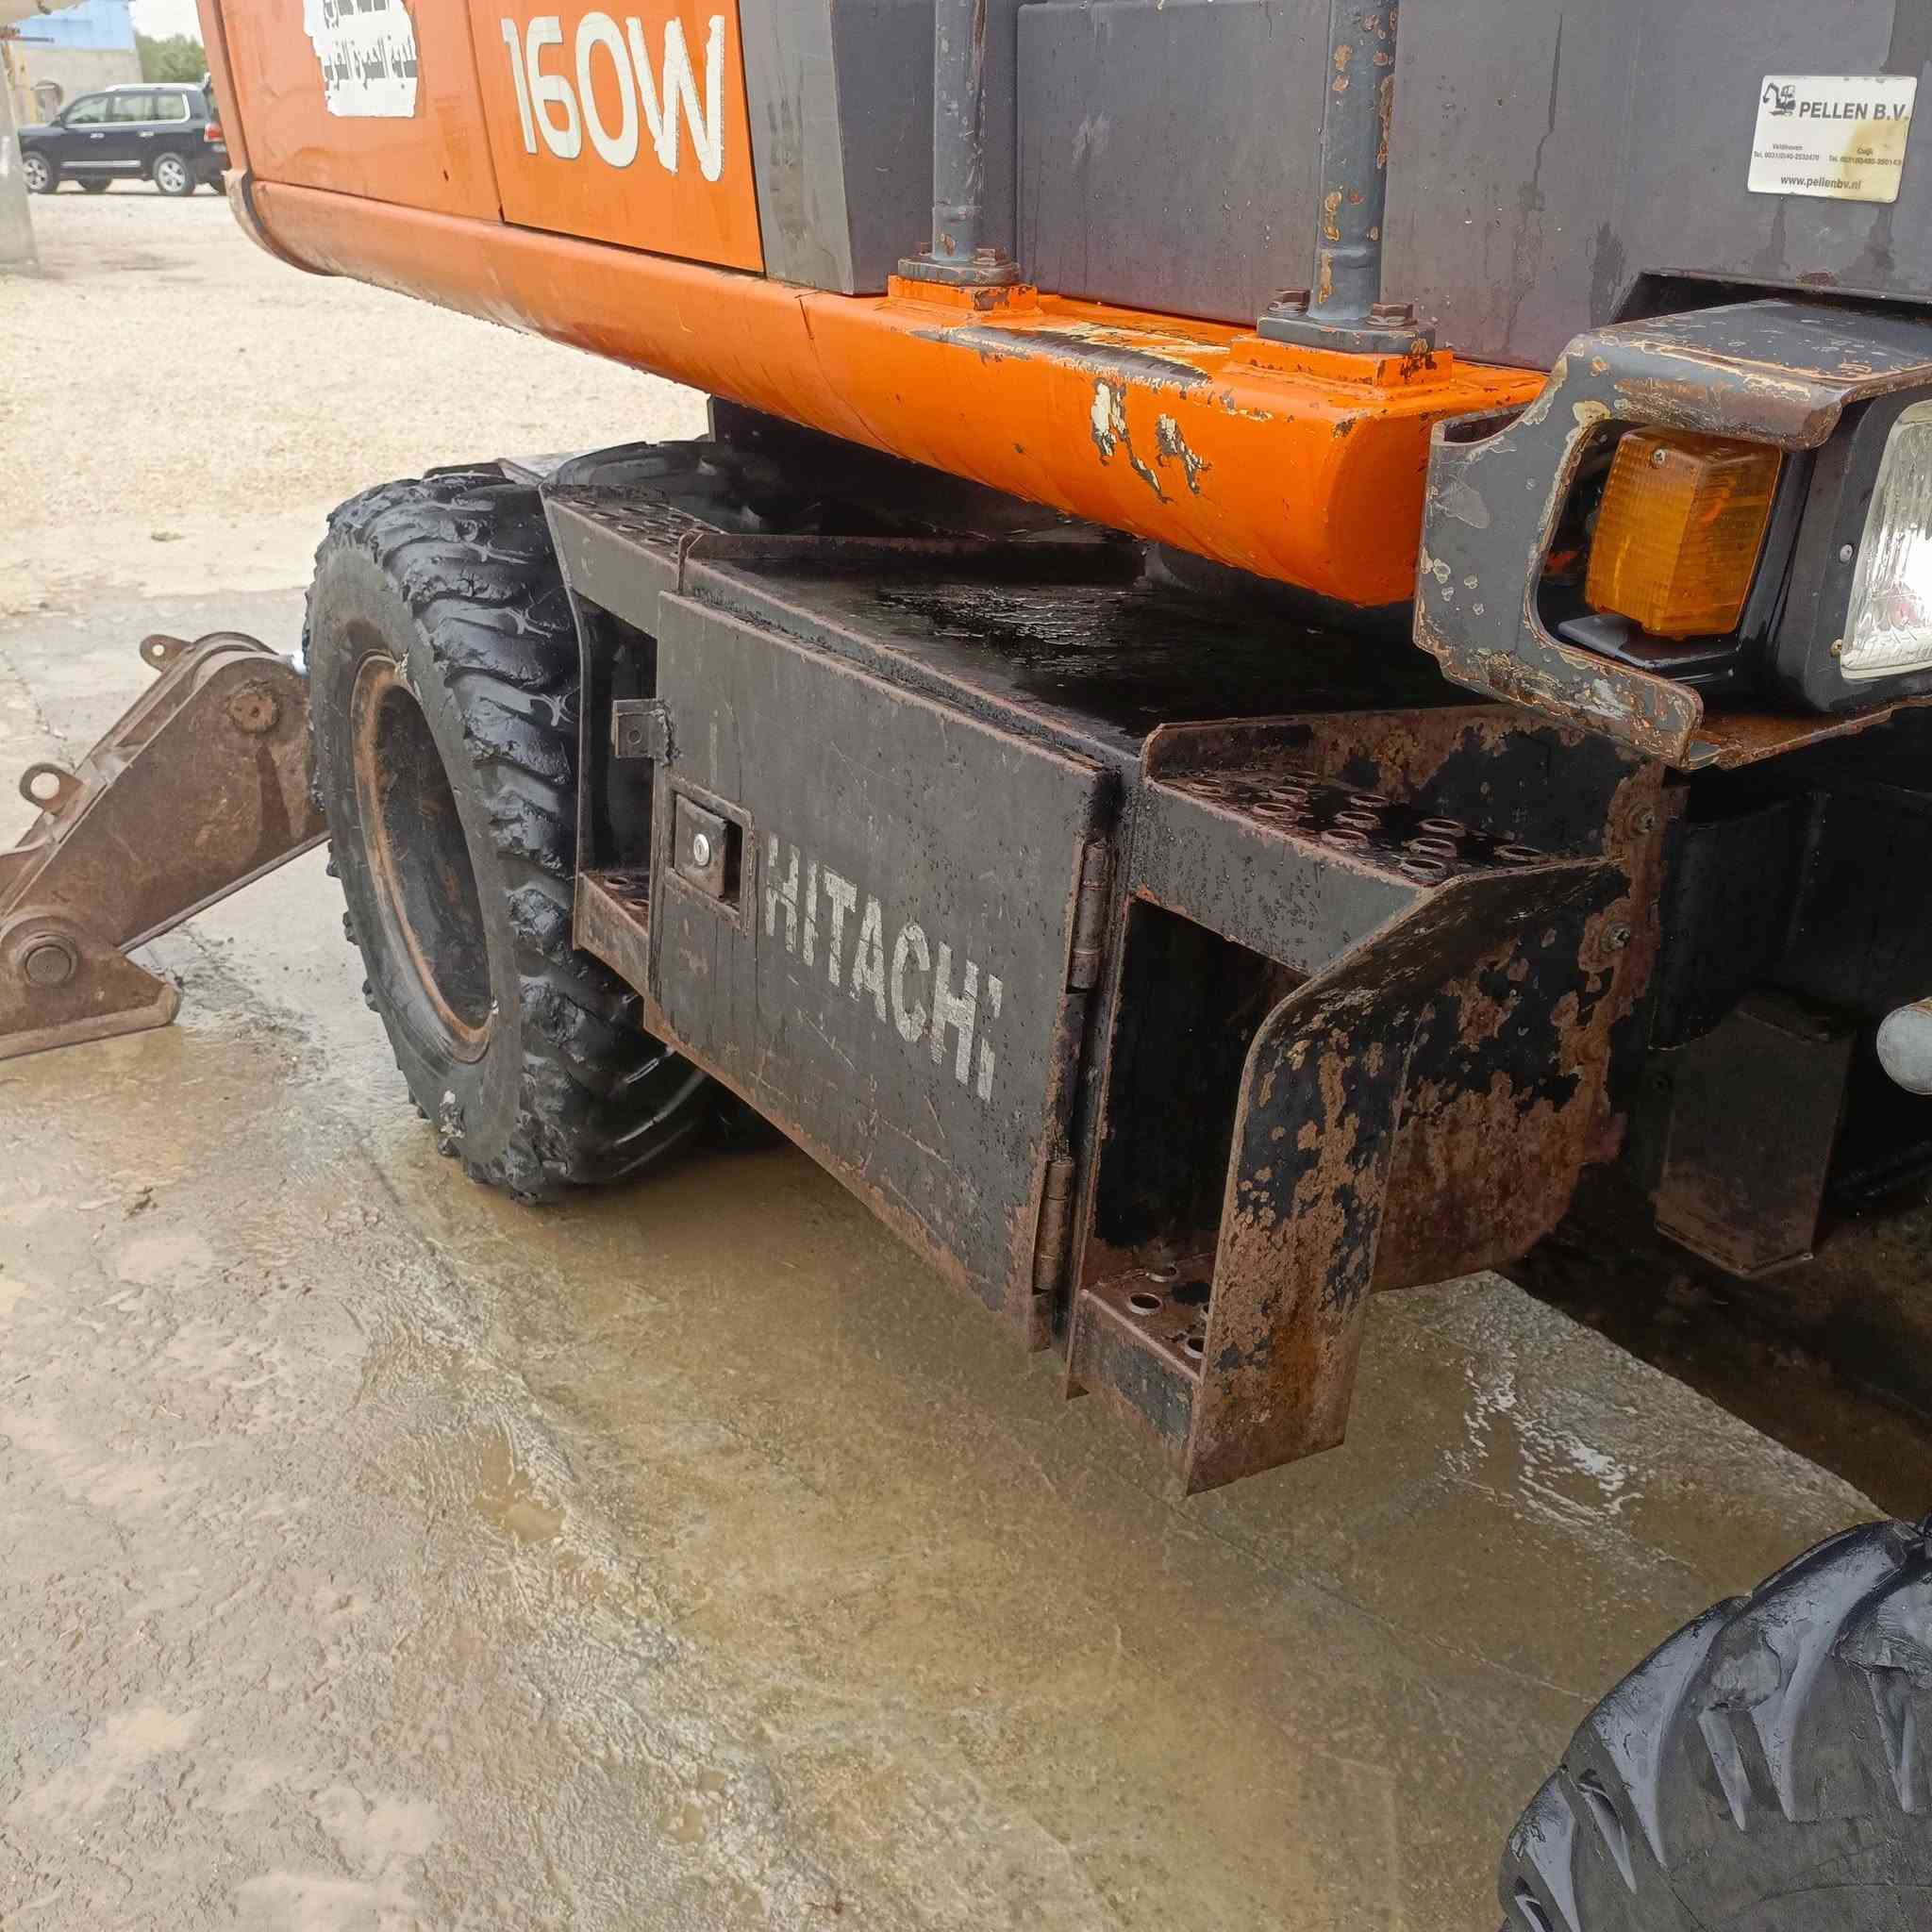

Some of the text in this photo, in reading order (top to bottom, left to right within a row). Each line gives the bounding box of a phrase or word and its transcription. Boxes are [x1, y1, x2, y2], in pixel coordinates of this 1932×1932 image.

[500, 11, 724, 181] 160W
[1799, 102, 1868, 120] PELLEN
[1780, 175, 1862, 190] www.pellenbv.nl
[765, 834, 1004, 1103] HITACHI
